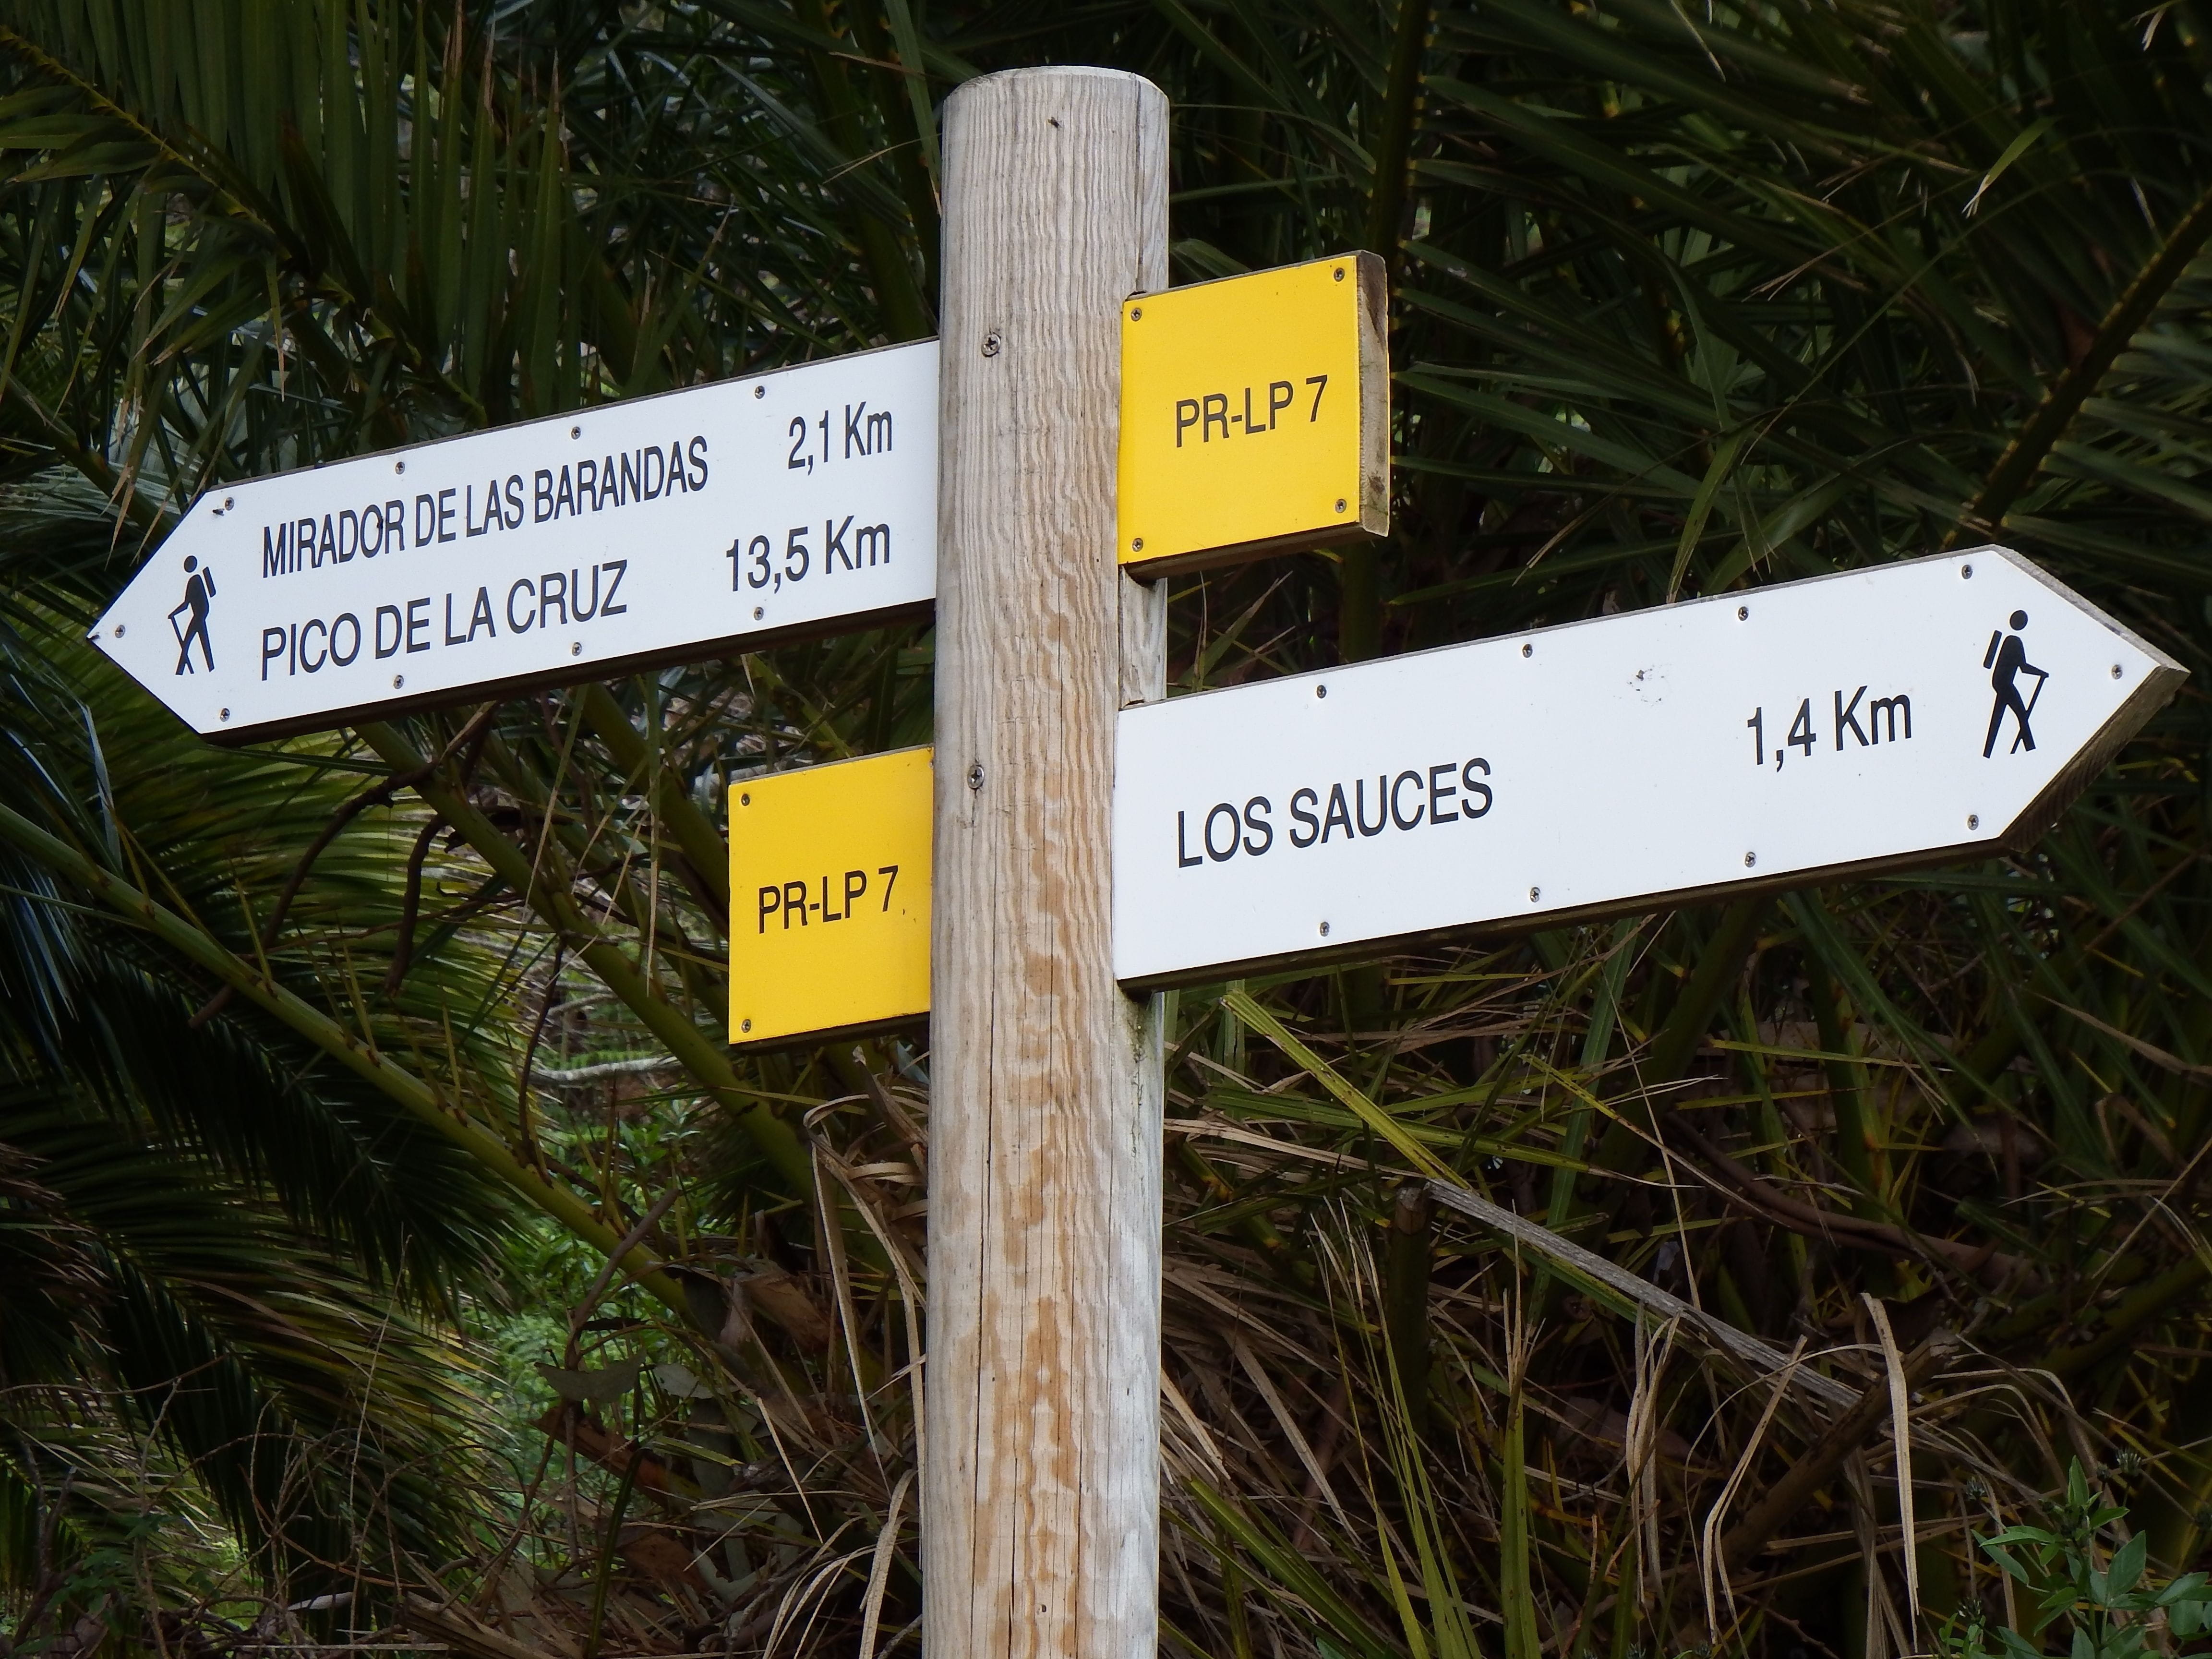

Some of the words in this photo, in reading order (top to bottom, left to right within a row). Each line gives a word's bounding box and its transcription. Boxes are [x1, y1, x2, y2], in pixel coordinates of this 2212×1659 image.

[263, 499, 405, 578] MIRADOR
[415, 488, 457, 548] DE
[466, 474, 524, 538] LAS
[534, 435, 709, 524] BARANDAS
[788, 409, 829, 475] 2,1
[844, 401, 892, 459] Km
[1176, 380, 1294, 448] PR-LP
[1305, 374, 1328, 423] 7
[261, 612, 361, 682] PICO
[375, 597, 431, 660] DE
[445, 586, 497, 647] LA
[506, 559, 627, 634] CRUZ
[726, 526, 810, 594] 13,5
[825, 515, 890, 575] Km
[1178, 795, 1274, 869] LOS
[1289, 757, 1493, 849] SAUCES
[1747, 697, 1817, 773] 1,4
[1834, 685, 1912, 752] Km
[758, 869, 867, 935] PR-LP
[878, 865, 899, 913] 7
